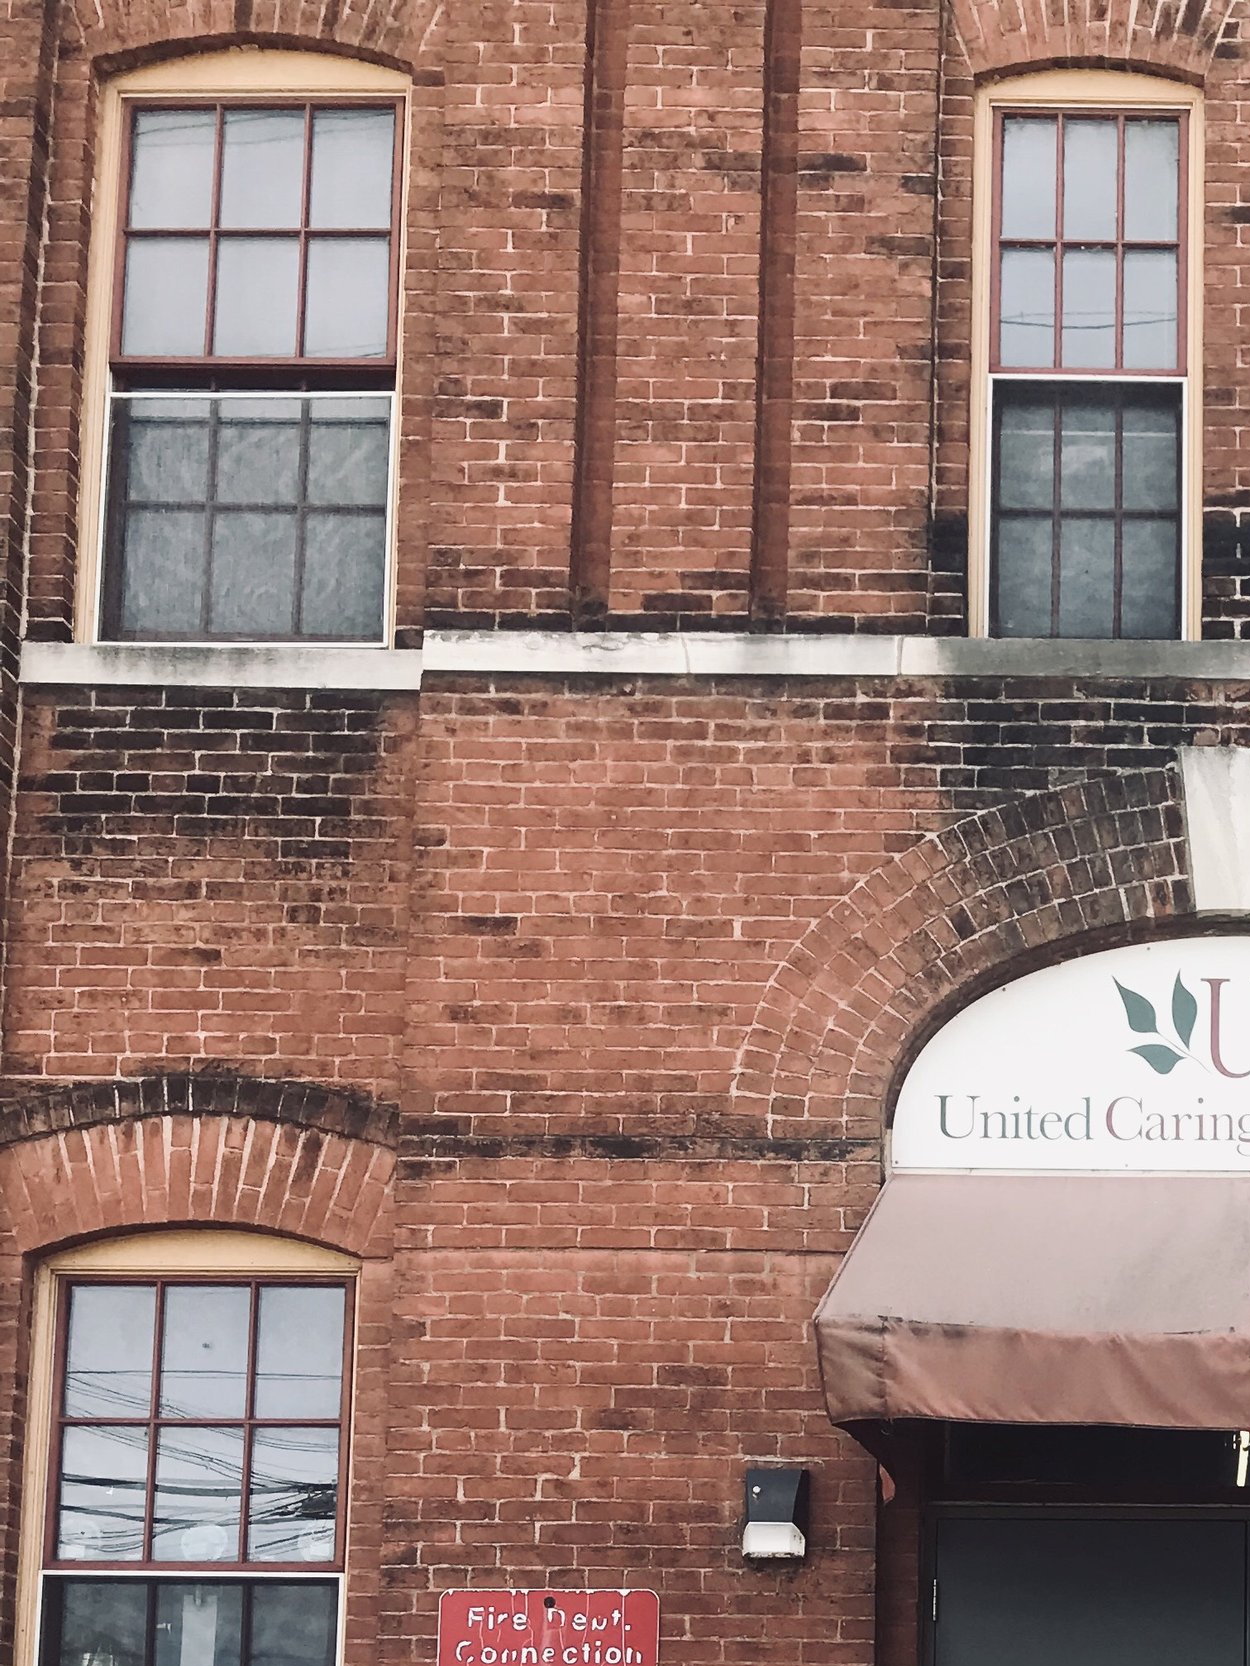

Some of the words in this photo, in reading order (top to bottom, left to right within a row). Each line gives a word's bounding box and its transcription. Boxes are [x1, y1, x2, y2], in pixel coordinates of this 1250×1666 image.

[935, 1094, 1093, 1141] United
[467, 1606, 529, 1631] Fire
[455, 1640, 642, 1664] Connection
